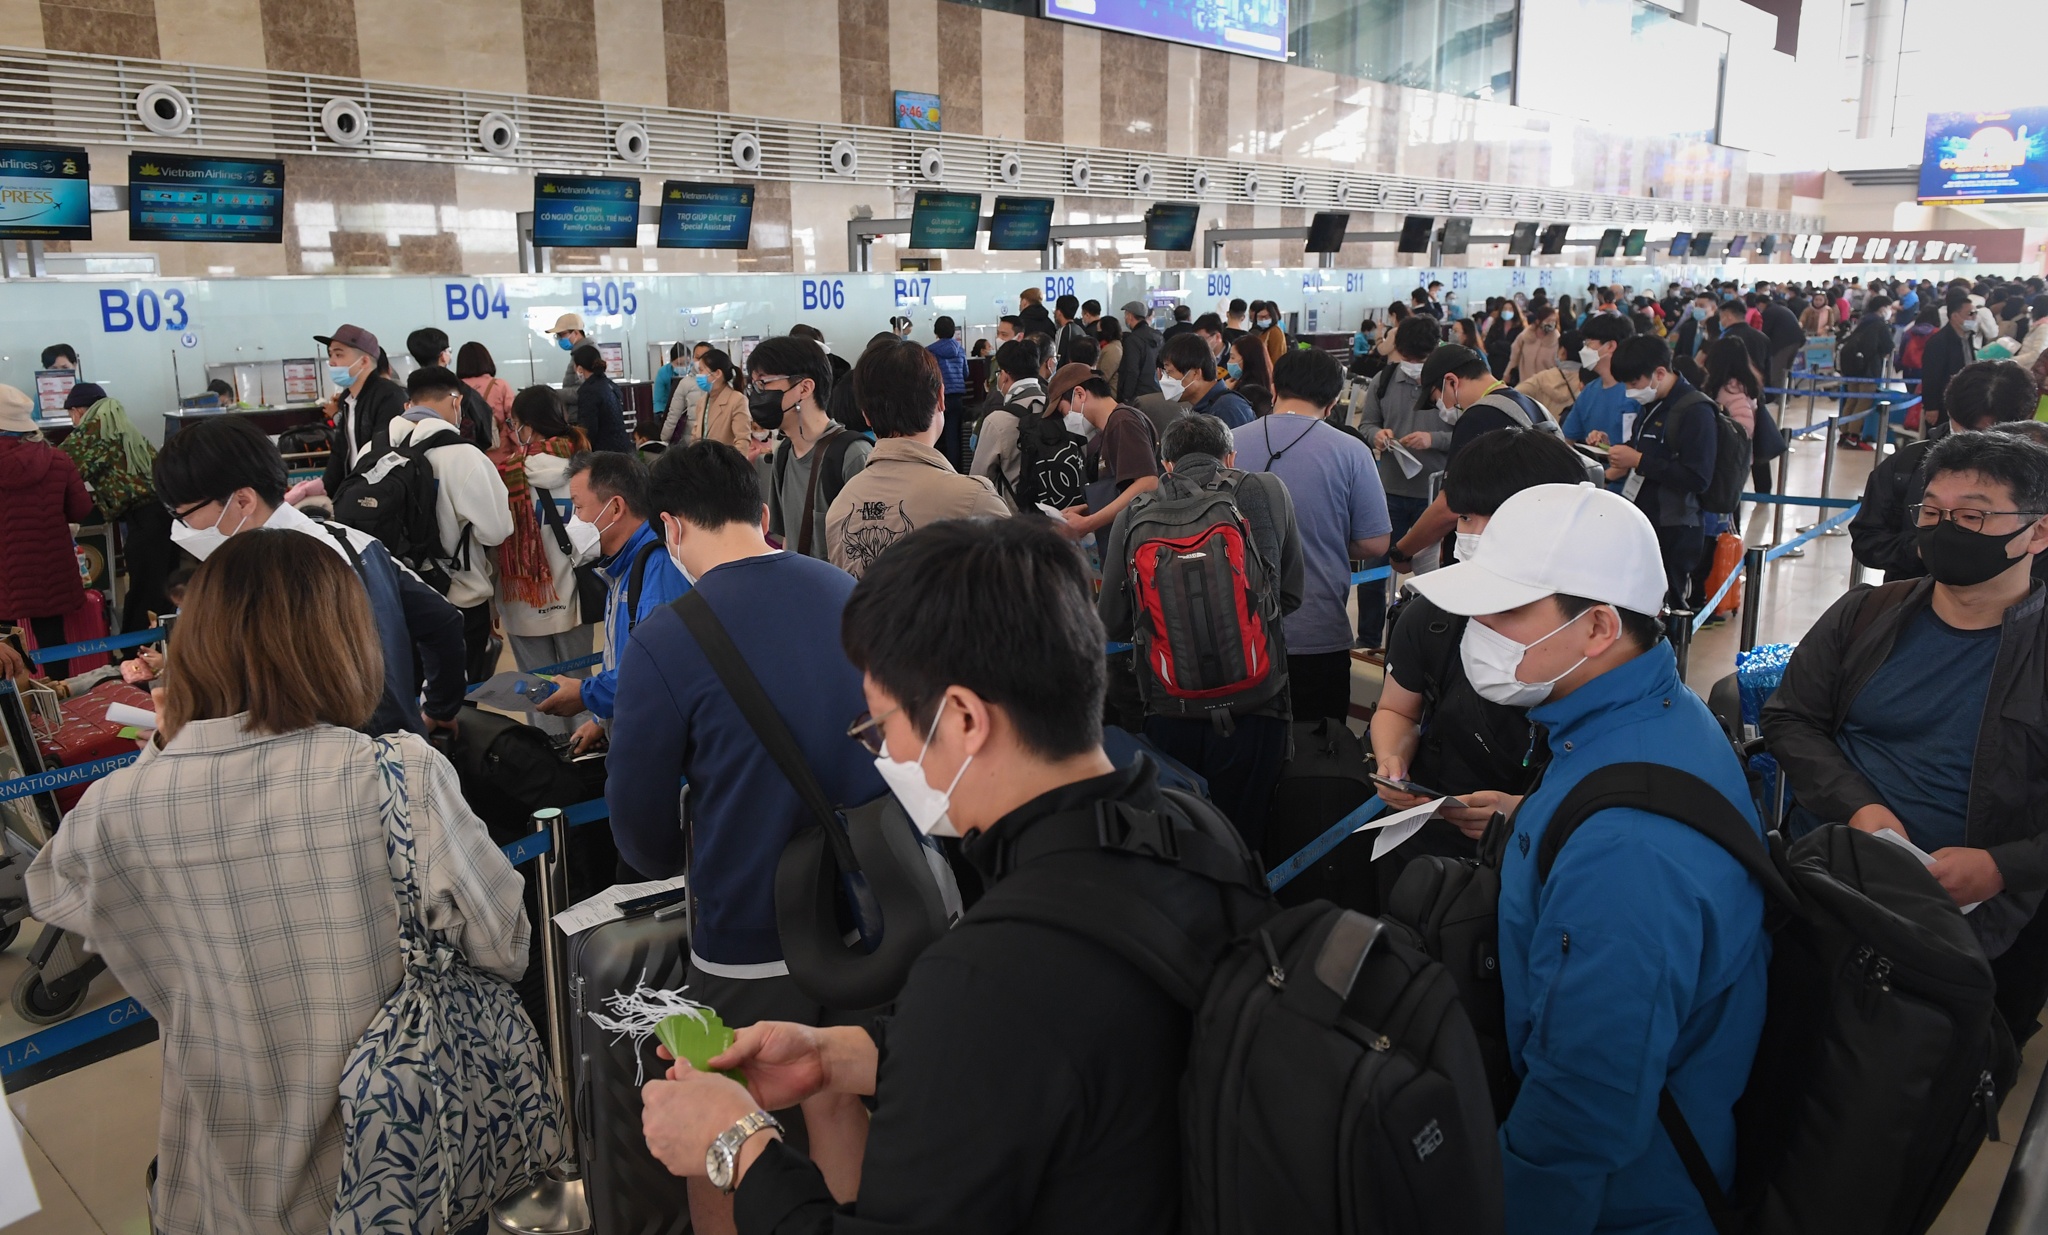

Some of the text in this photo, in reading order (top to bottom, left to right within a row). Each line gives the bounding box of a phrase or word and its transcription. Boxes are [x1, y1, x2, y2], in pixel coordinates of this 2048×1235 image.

[900, 104, 922, 118] 9:46
[0, 159, 38, 169] irlines
[161, 167, 242, 180] Vietnam Airlines
[0, 188, 54, 205] PRESS
[557, 186, 610, 195] Vietnam Airlines
[541, 212, 551, 220] CÓ
[574, 213, 588, 221] CAO
[563, 223, 584, 232] Family
[681, 223, 731, 231] Special Assistant
[1208, 274, 1231, 296] B09
[1346, 272, 1364, 292] B11
[1453, 271, 1468, 289] B13
[802, 279, 844, 310] B06
[894, 278, 931, 307] B07
[1045, 276, 1075, 302] B08
[445, 283, 510, 321] B04
[582, 281, 637, 316] B05
[99, 288, 189, 332] B03
[77, 641, 107, 653] N.I.A
